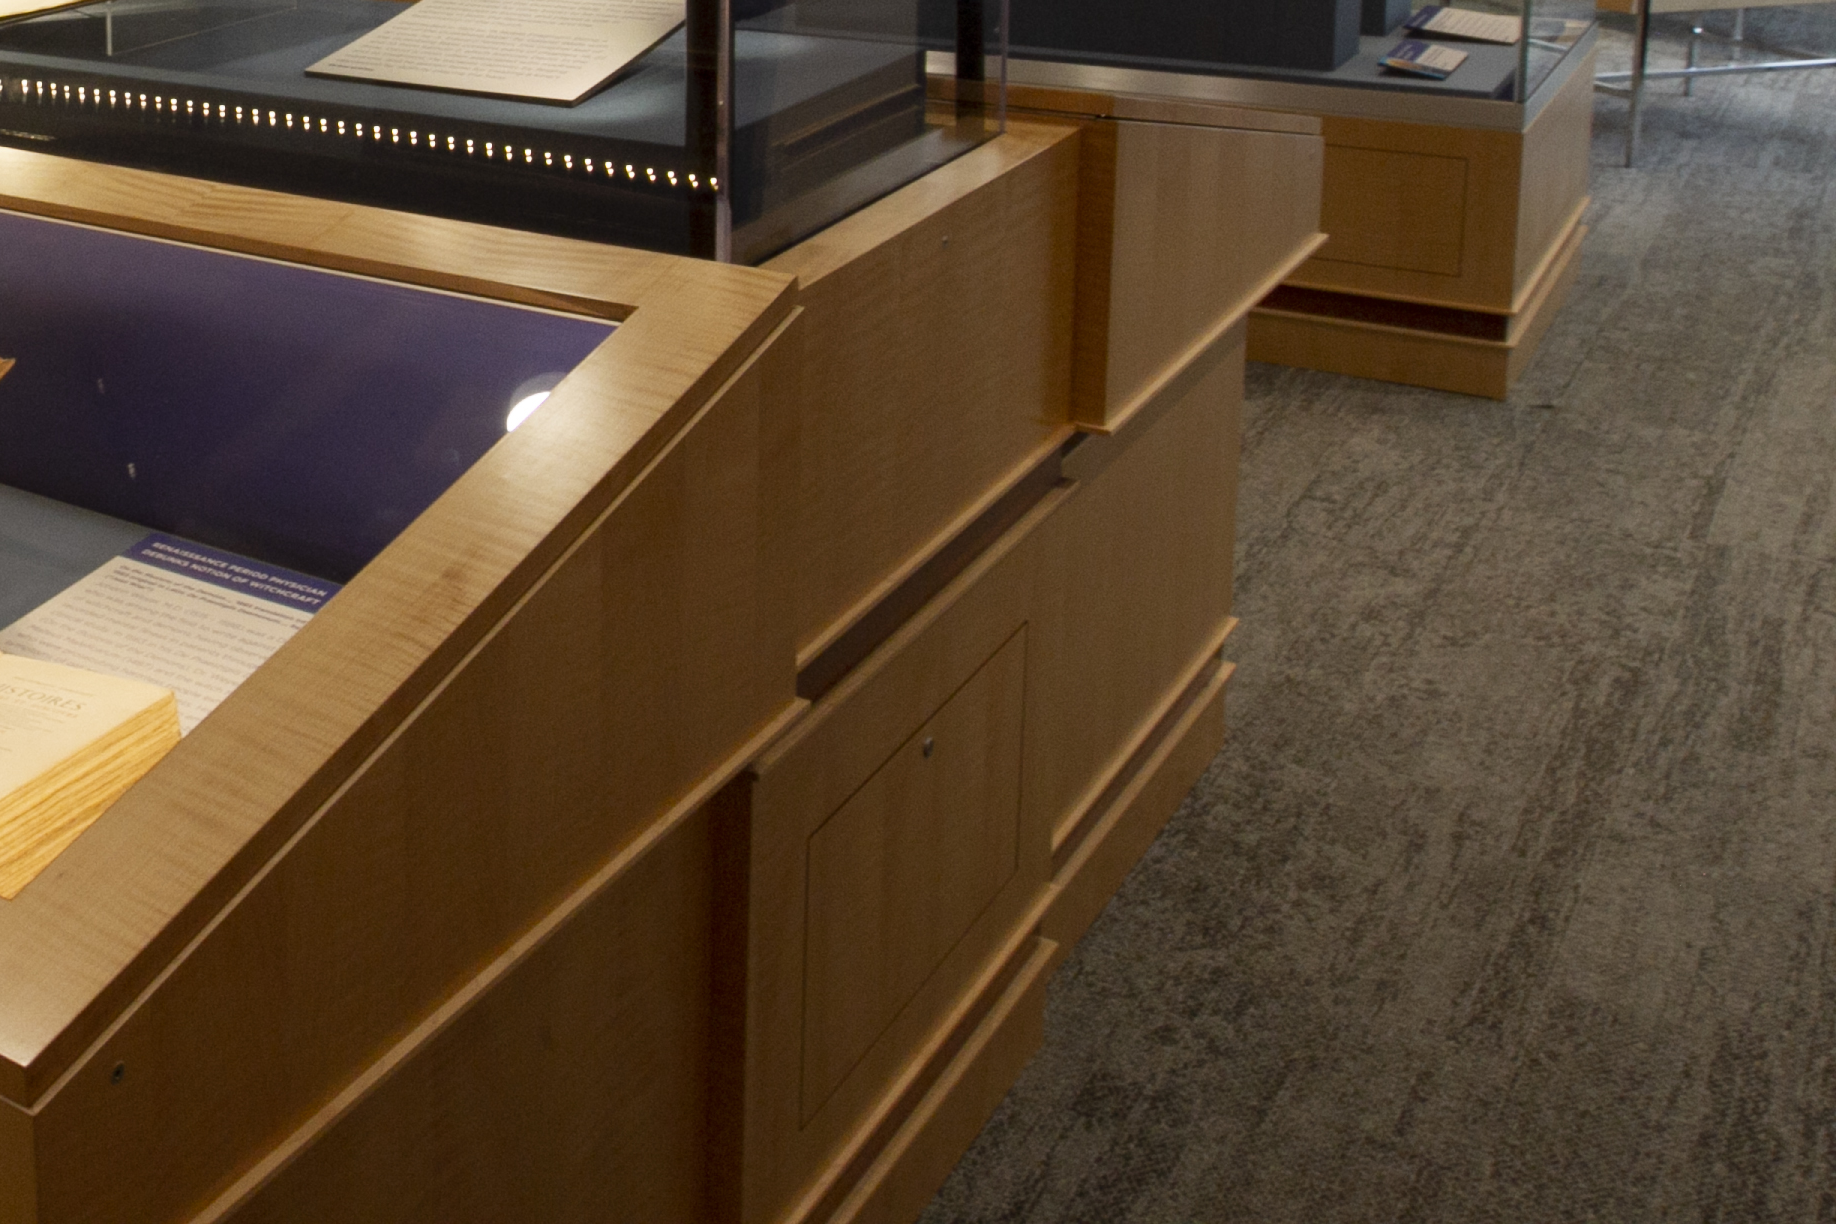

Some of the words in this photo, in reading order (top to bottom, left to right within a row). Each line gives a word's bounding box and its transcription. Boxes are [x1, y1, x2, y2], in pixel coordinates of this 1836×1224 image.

[140, 548, 190, 568] DEBUNKS
[189, 561, 232, 580] NOTION
[231, 575, 249, 584] OF
[249, 579, 322, 605] WITCHCRAFT
[151, 541, 228, 569] RENAISSANCE
[228, 563, 269, 581] PERIOD
[268, 575, 328, 597] PHYSICIAN
